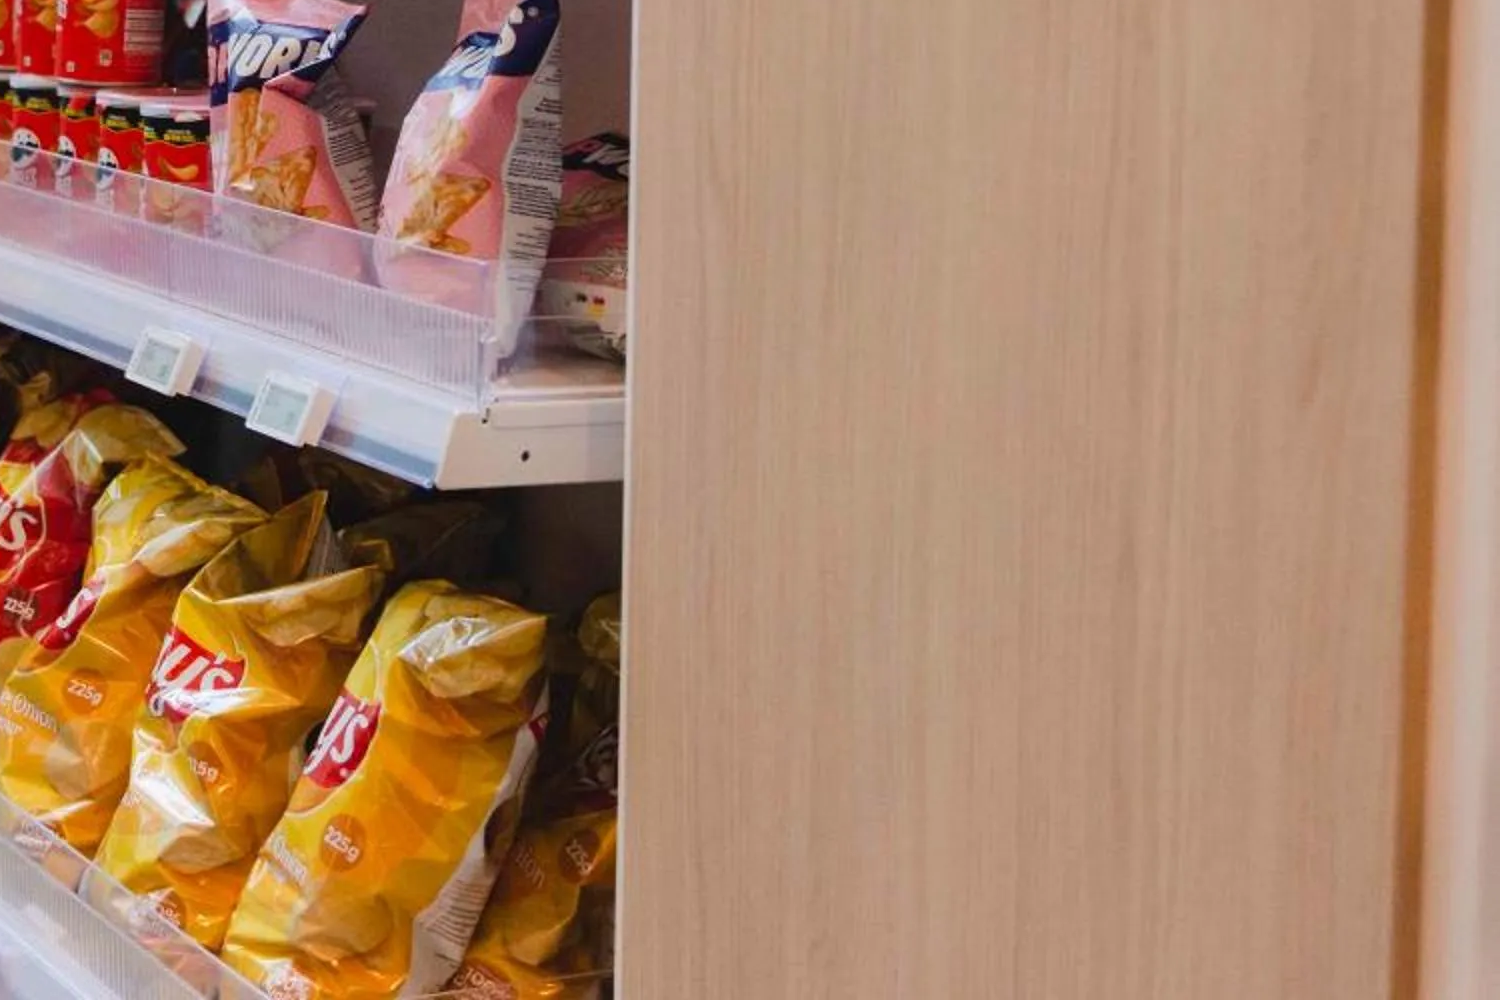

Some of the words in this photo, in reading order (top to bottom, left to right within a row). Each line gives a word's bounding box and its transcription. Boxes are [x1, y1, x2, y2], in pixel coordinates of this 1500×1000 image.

[3, 597, 35, 621] 225g
[67, 679, 103, 708] 225g
[323, 824, 361, 864] 225g
